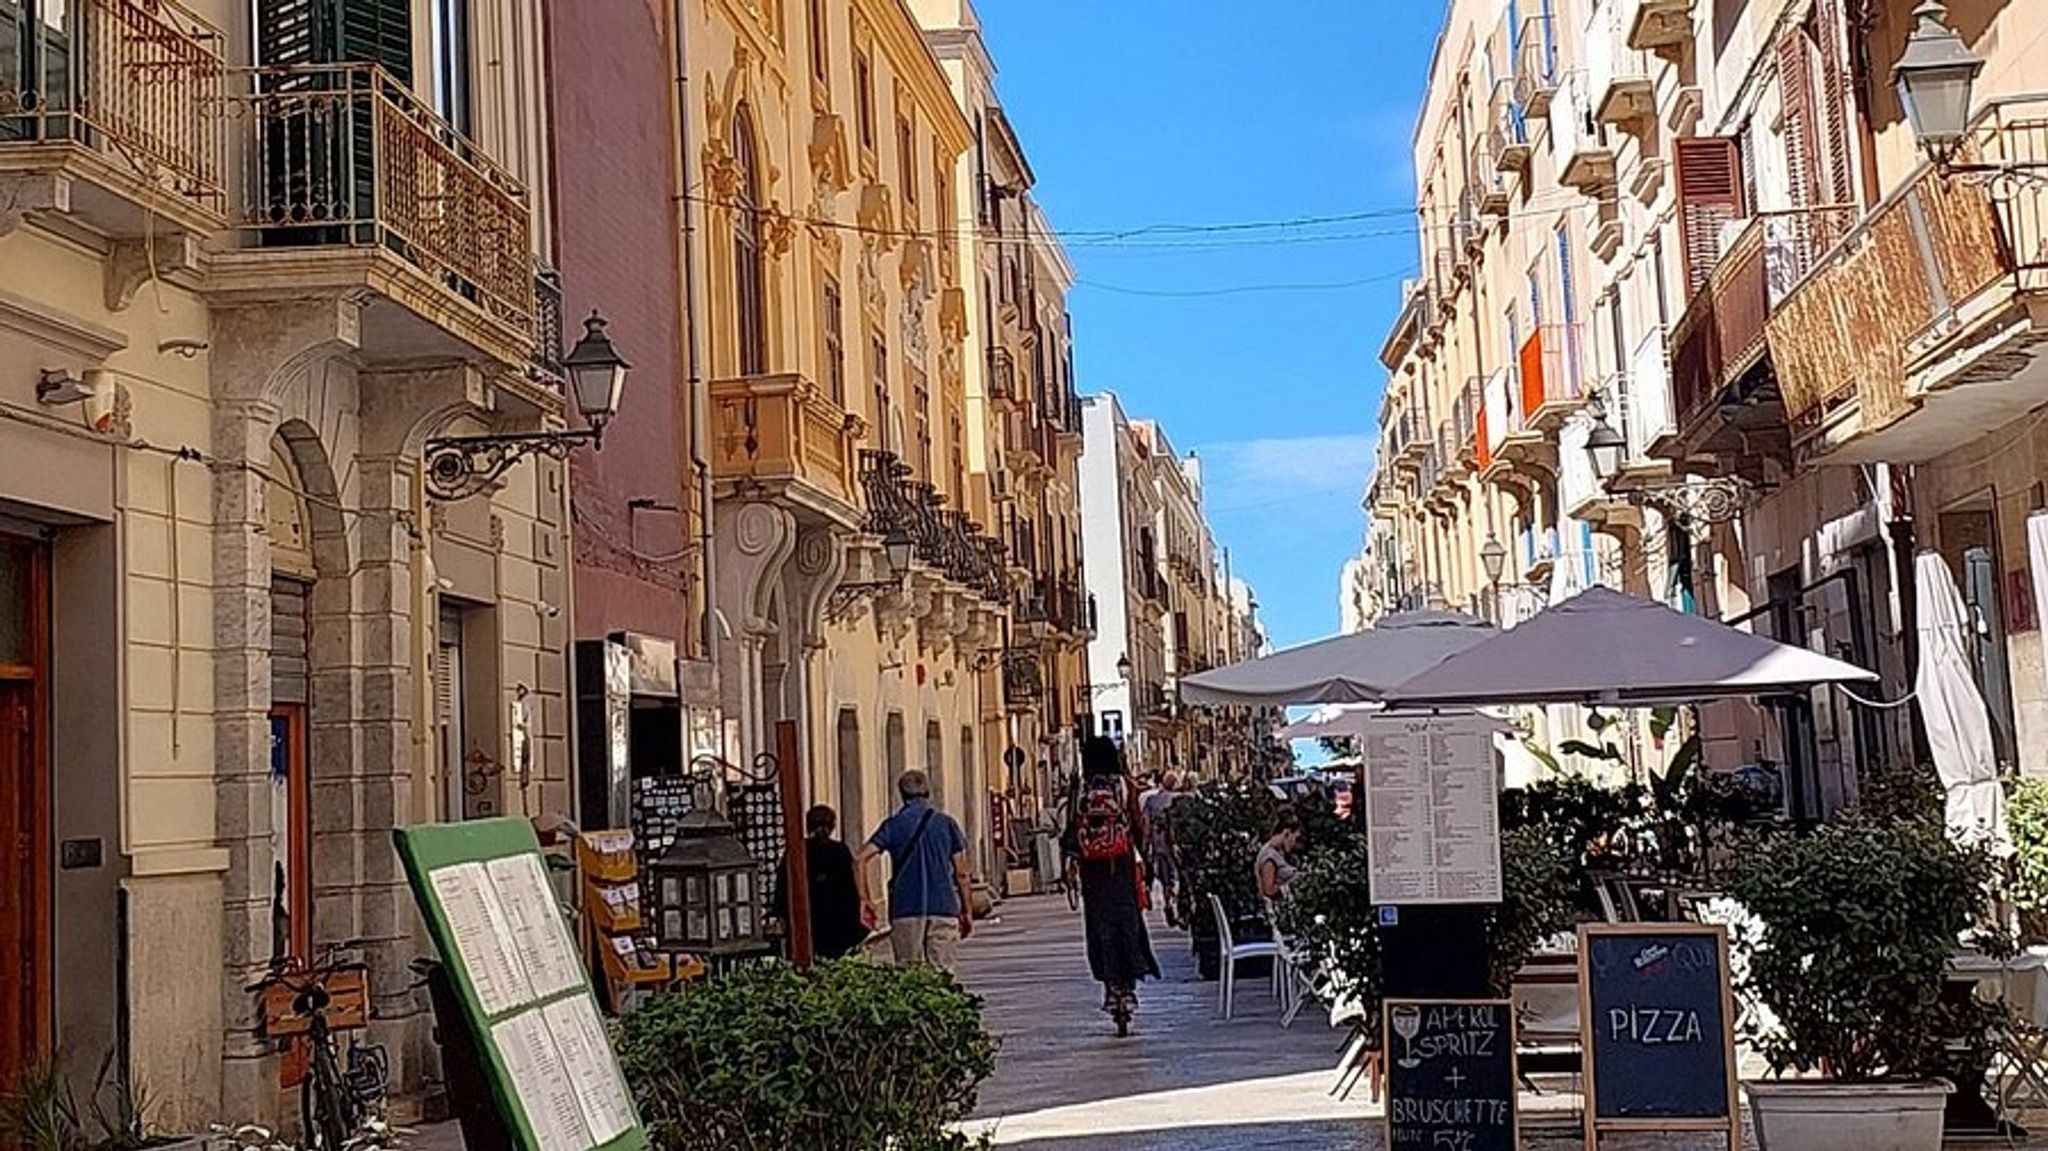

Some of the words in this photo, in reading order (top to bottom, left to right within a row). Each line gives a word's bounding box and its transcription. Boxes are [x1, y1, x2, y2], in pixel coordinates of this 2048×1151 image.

[1426, 1006, 1499, 1030] APEROL
[1608, 1004, 1702, 1042] PIZZA
[1411, 1031, 1494, 1057] SPRITZ
[1392, 1097, 1508, 1125] BRUSCHETTE
